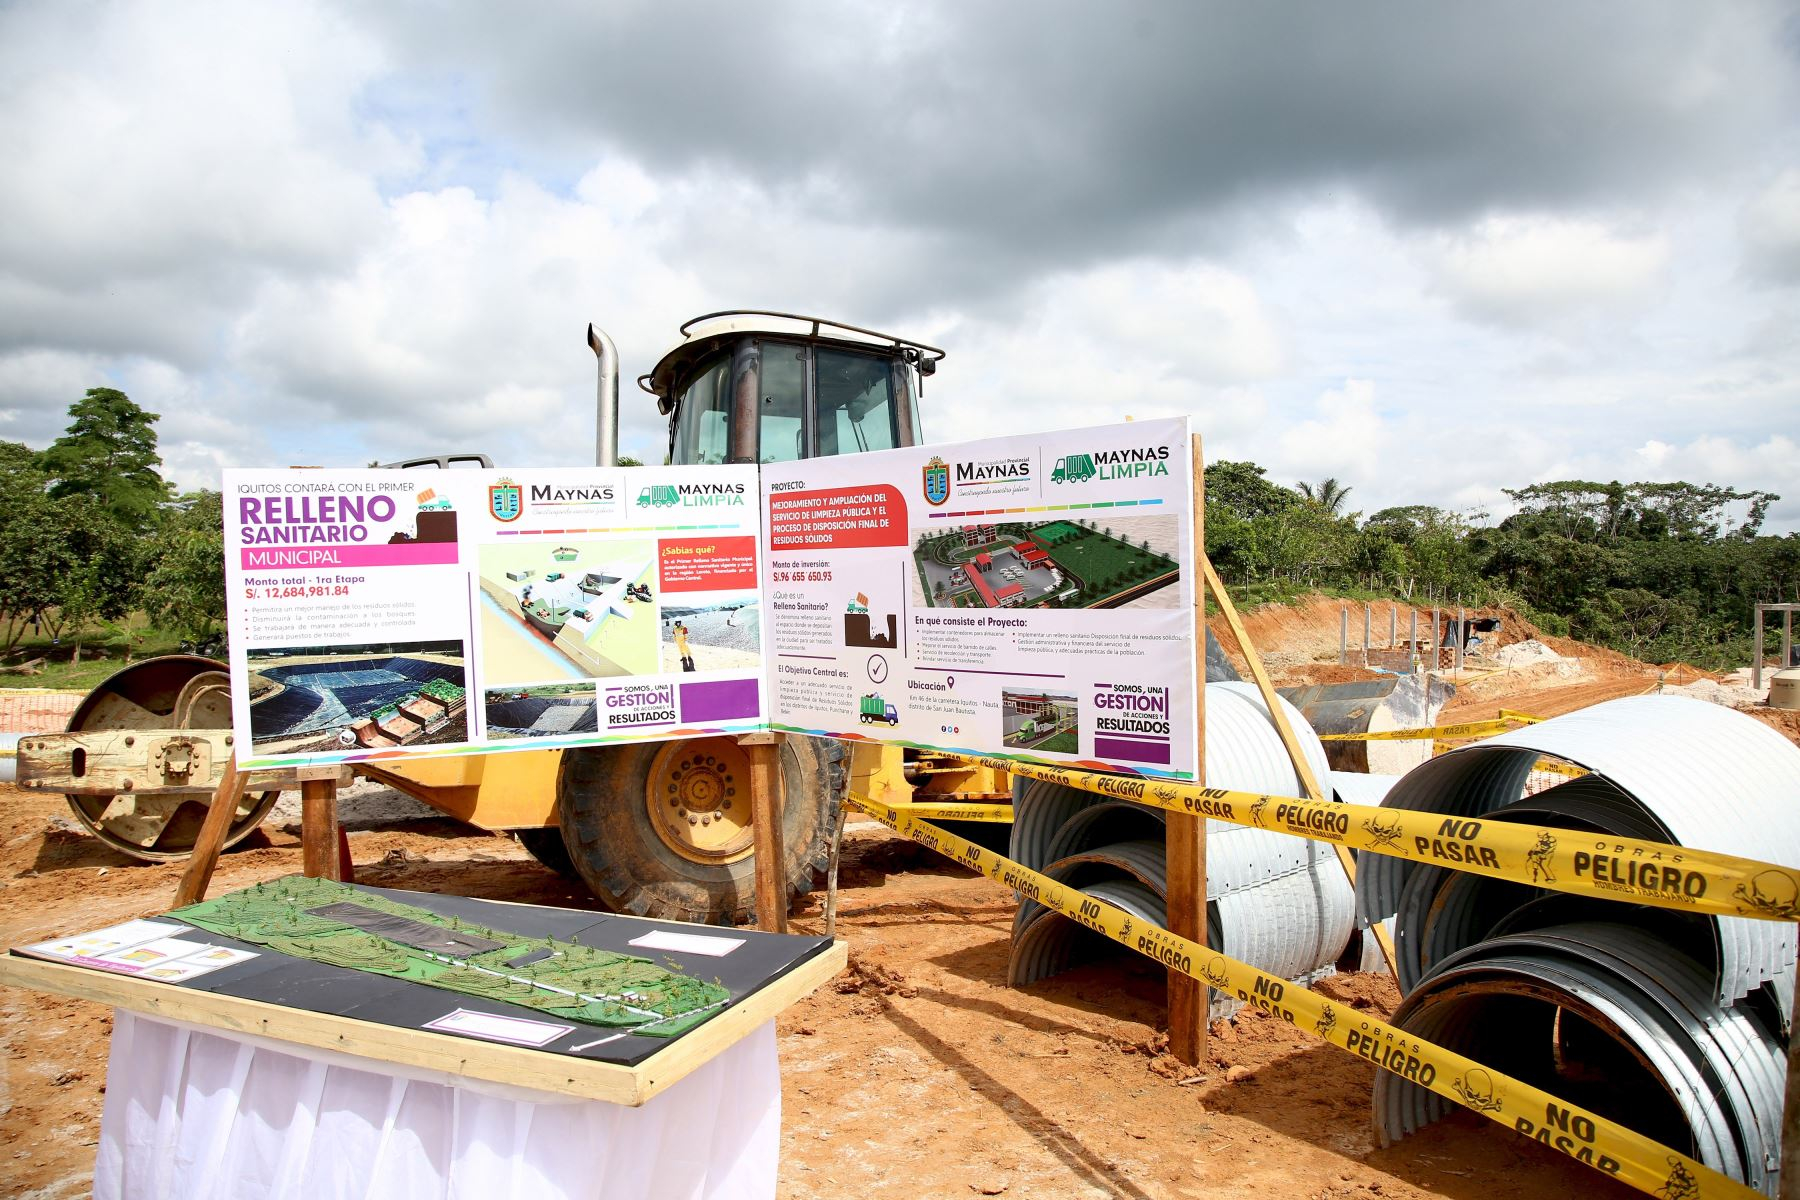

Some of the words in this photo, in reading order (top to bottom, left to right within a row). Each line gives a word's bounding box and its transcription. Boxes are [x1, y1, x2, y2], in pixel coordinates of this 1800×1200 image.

[1095, 446, 1169, 465] MAYNAS
[957, 462, 1029, 480] MAYNAS
[1100, 461, 1168, 480] LIMPIA
[238, 484, 281, 493] IQUITOS
[285, 482, 335, 492] CONTARÁ
[338, 483, 362, 492] CON
[366, 483, 376, 492] EL
[379, 483, 414, 492] PRIMER
[531, 485, 614, 500] MAYNAS
[679, 484, 745, 494] MAYNAS
[772, 481, 805, 491] PROYECTO:
[684, 495, 744, 506] LIMPIA
[773, 498, 821, 510] MEJORAMIENTO
[829, 494, 872, 506] AMPLIACIÓN
[240, 495, 396, 524] RELLENO
[773, 511, 799, 521] SERVICIO
[802, 511, 810, 519] DE
[812, 509, 840, 518] LIMPIEZA
[843, 507, 871, 517] PÚBLICA
[241, 525, 368, 544] SANITARIO
[773, 524, 801, 533] PROCESO
[813, 520, 856, 530] DISPOSICIÓN
[858, 520, 878, 528] FINAL
[774, 535, 803, 544] RESIDUOS
[805, 533, 832, 543] SÓLIDOS
[250, 550, 341, 566] MUNICIPAL
[696, 546, 715, 555] qué?
[336, 576, 365, 584] Etapa
[246, 589, 260, 599] S/.
[265, 586, 349, 598] 12,684,981.84
[797, 602, 828, 610] Sanitario?
[916, 616, 924, 624] En
[926, 617, 940, 626] qué
[943, 617, 975, 626] consiste
[978, 617, 985, 626] el
[988, 617, 1027, 628] Proyecto:
[785, 665, 811, 675] Objetivo
[813, 668, 837, 676] Central
[908, 680, 946, 691] Ubicación
[609, 711, 675, 724] RESULTADOS
[1097, 718, 1170, 734] RESULTADOS
[1098, 777, 1145, 798] PELIGRO
[886, 809, 896, 822] NO
[1184, 798, 1235, 820] PASAR
[1276, 804, 1349, 834] PELIGRO
[1438, 818, 1482, 841] NO
[912, 828, 938, 849] PELIGRO
[966, 846, 980, 860] NO
[1415, 836, 1500, 869] PASAR
[1596, 842, 1683, 863] OBRAS
[1574, 851, 1708, 899] PELIGRO
[1004, 872, 1039, 900] PELIGRO
[1592, 880, 1636, 894] HOMBRES
[1080, 900, 1100, 919] NO
[1148, 930, 1184, 950] OBRAS
[1138, 935, 1191, 975] PELIGRO
[1253, 975, 1284, 1002] NO
[1361, 1022, 1420, 1053] OBRAS
[1346, 1029, 1436, 1088] PELIGRO
[1545, 1102, 1595, 1144] NO
